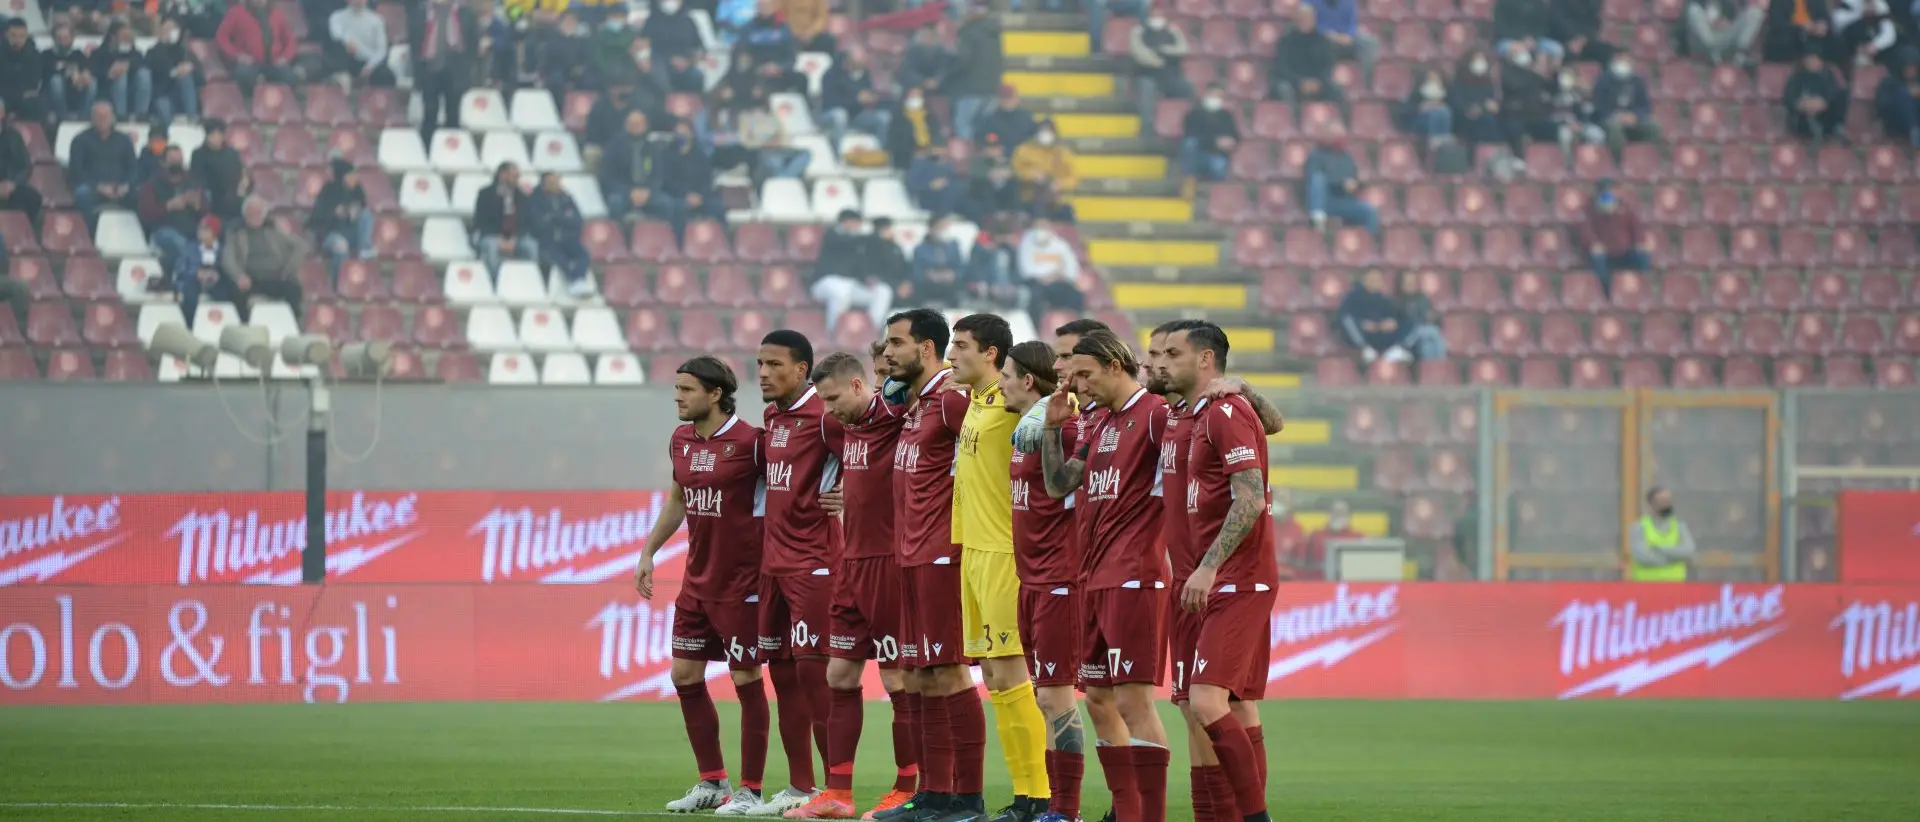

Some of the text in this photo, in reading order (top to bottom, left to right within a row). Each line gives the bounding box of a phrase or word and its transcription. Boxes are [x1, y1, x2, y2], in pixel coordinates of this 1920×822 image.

[1225, 448, 1255, 460] MAURO
[160, 600, 231, 686] &
[248, 595, 400, 703] figli
[873, 634, 898, 662] 20
[1547, 584, 1785, 675] Milwaukee
